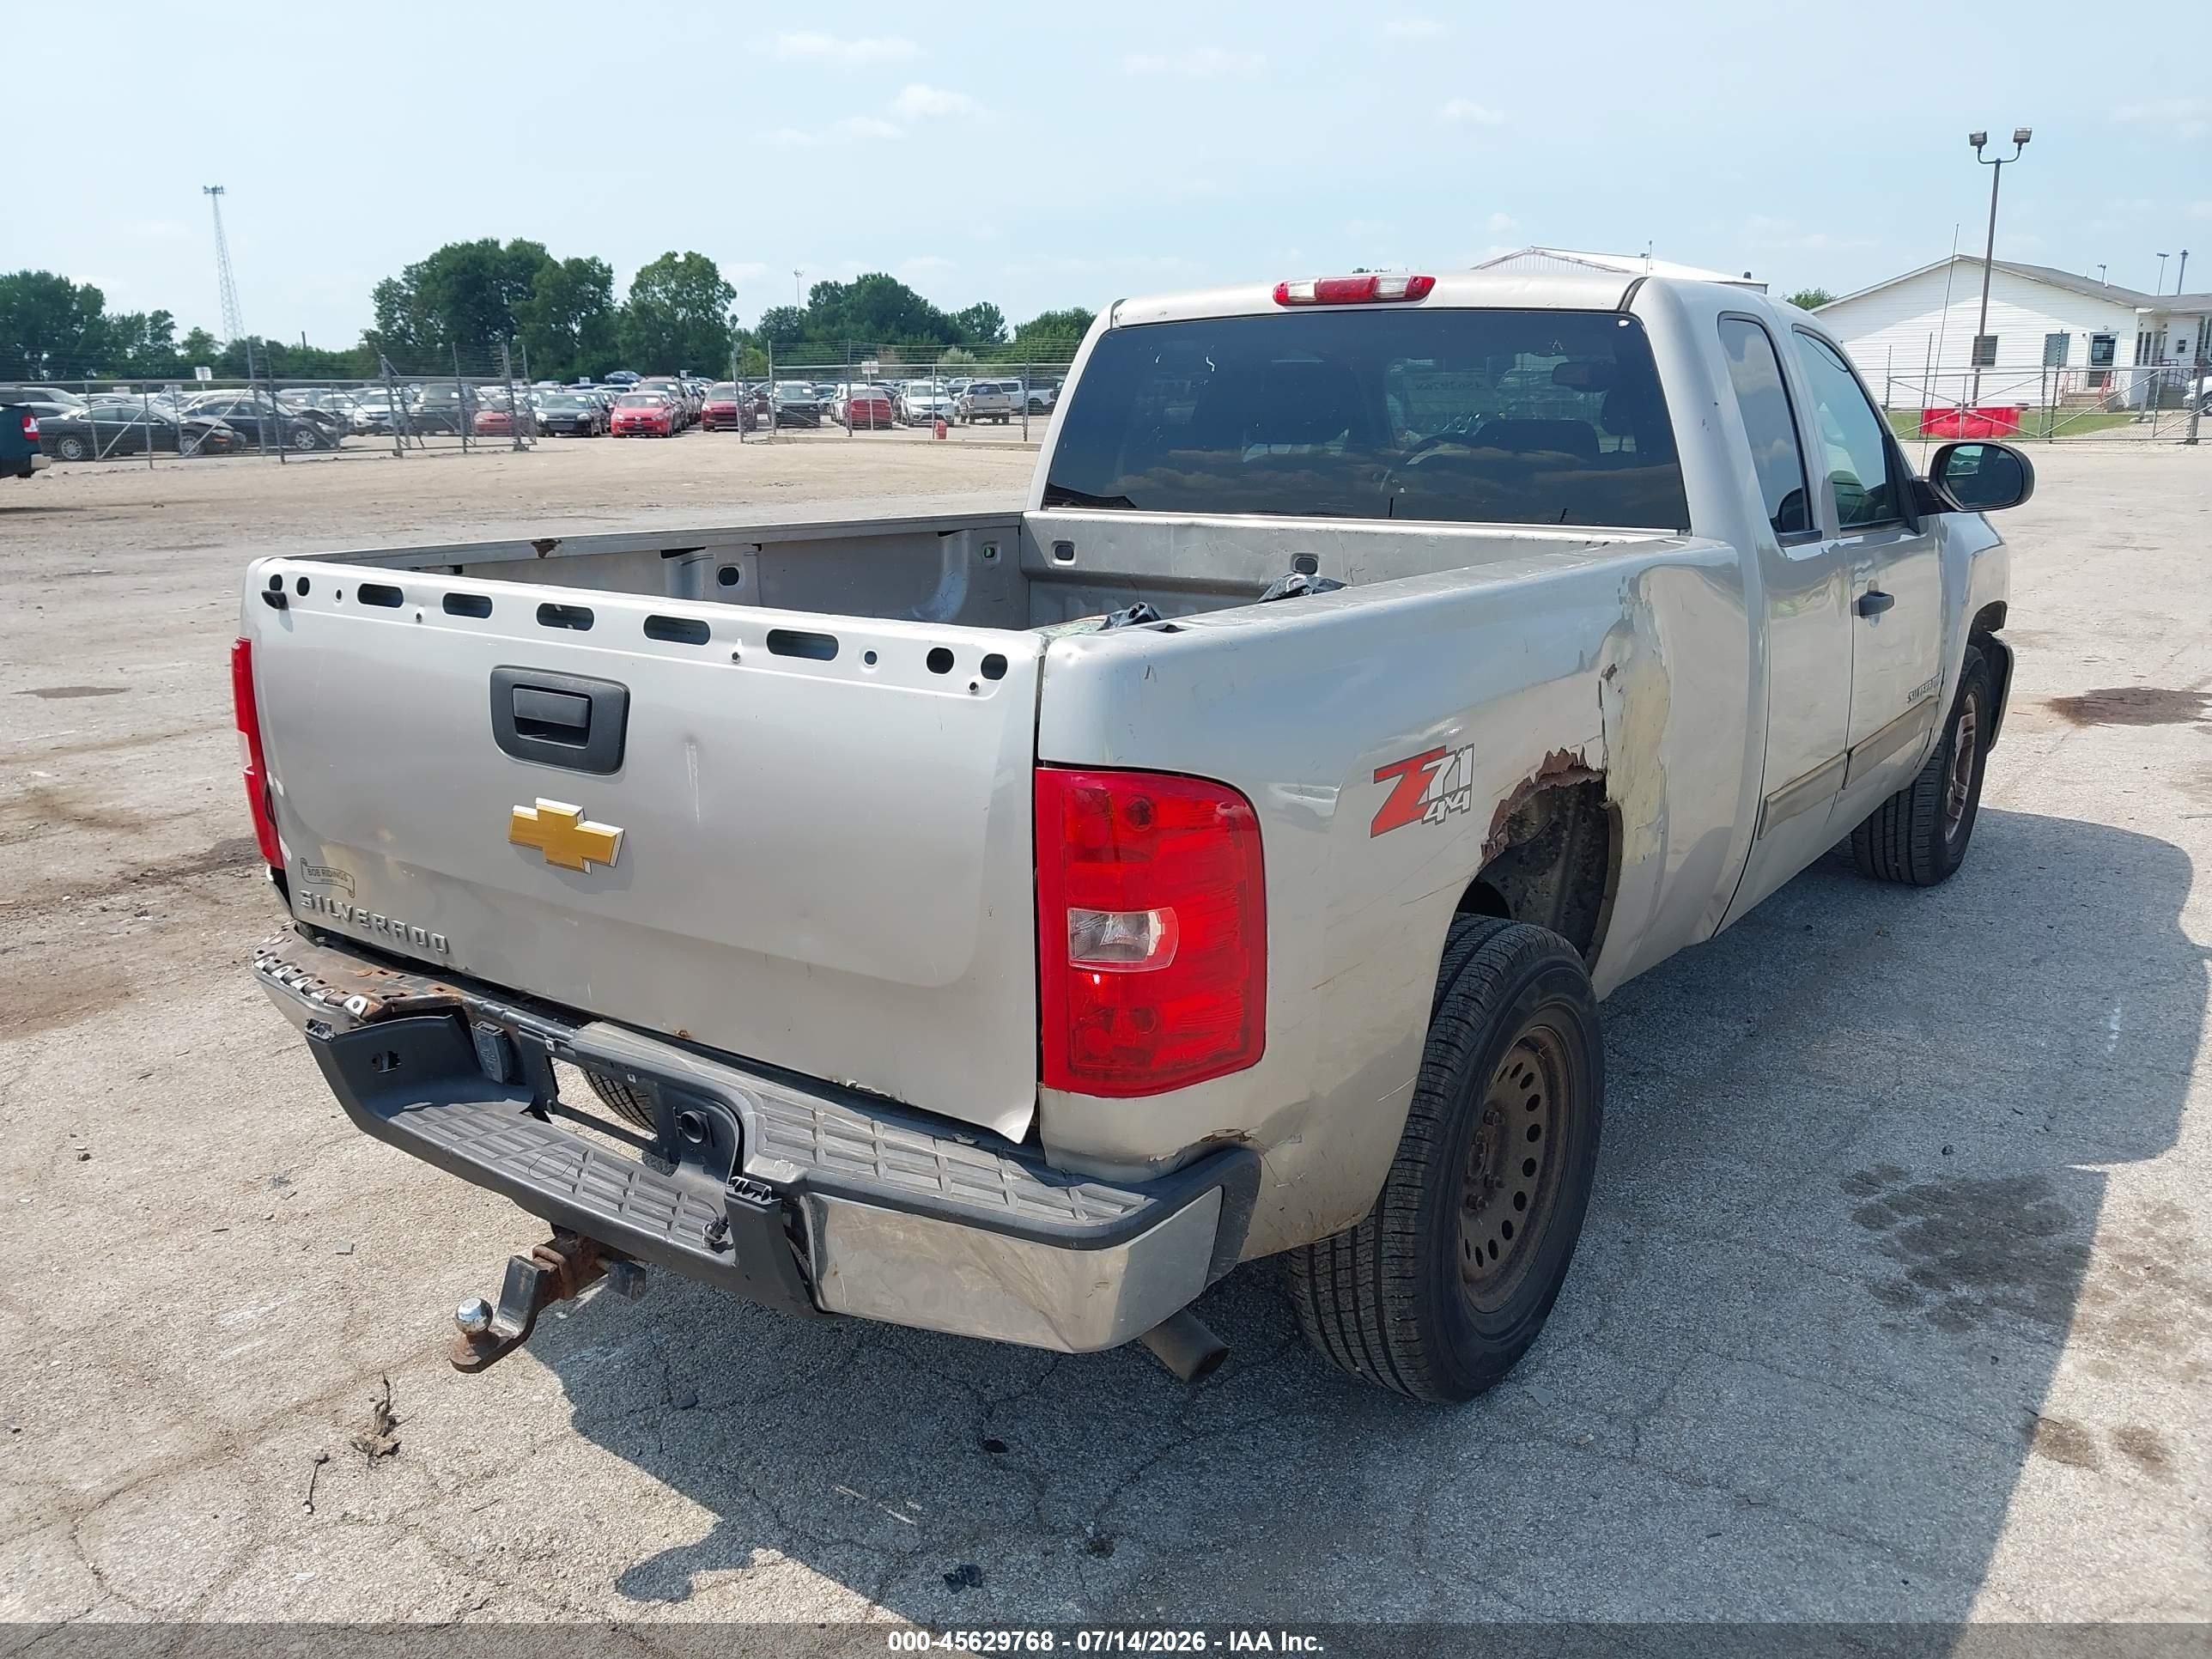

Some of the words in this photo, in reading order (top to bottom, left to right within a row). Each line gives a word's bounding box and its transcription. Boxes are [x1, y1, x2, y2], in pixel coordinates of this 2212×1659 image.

[1370, 743, 1474, 838] Z71
[307, 867, 321, 878] BOB
[299, 890, 449, 954] SILVERADO
